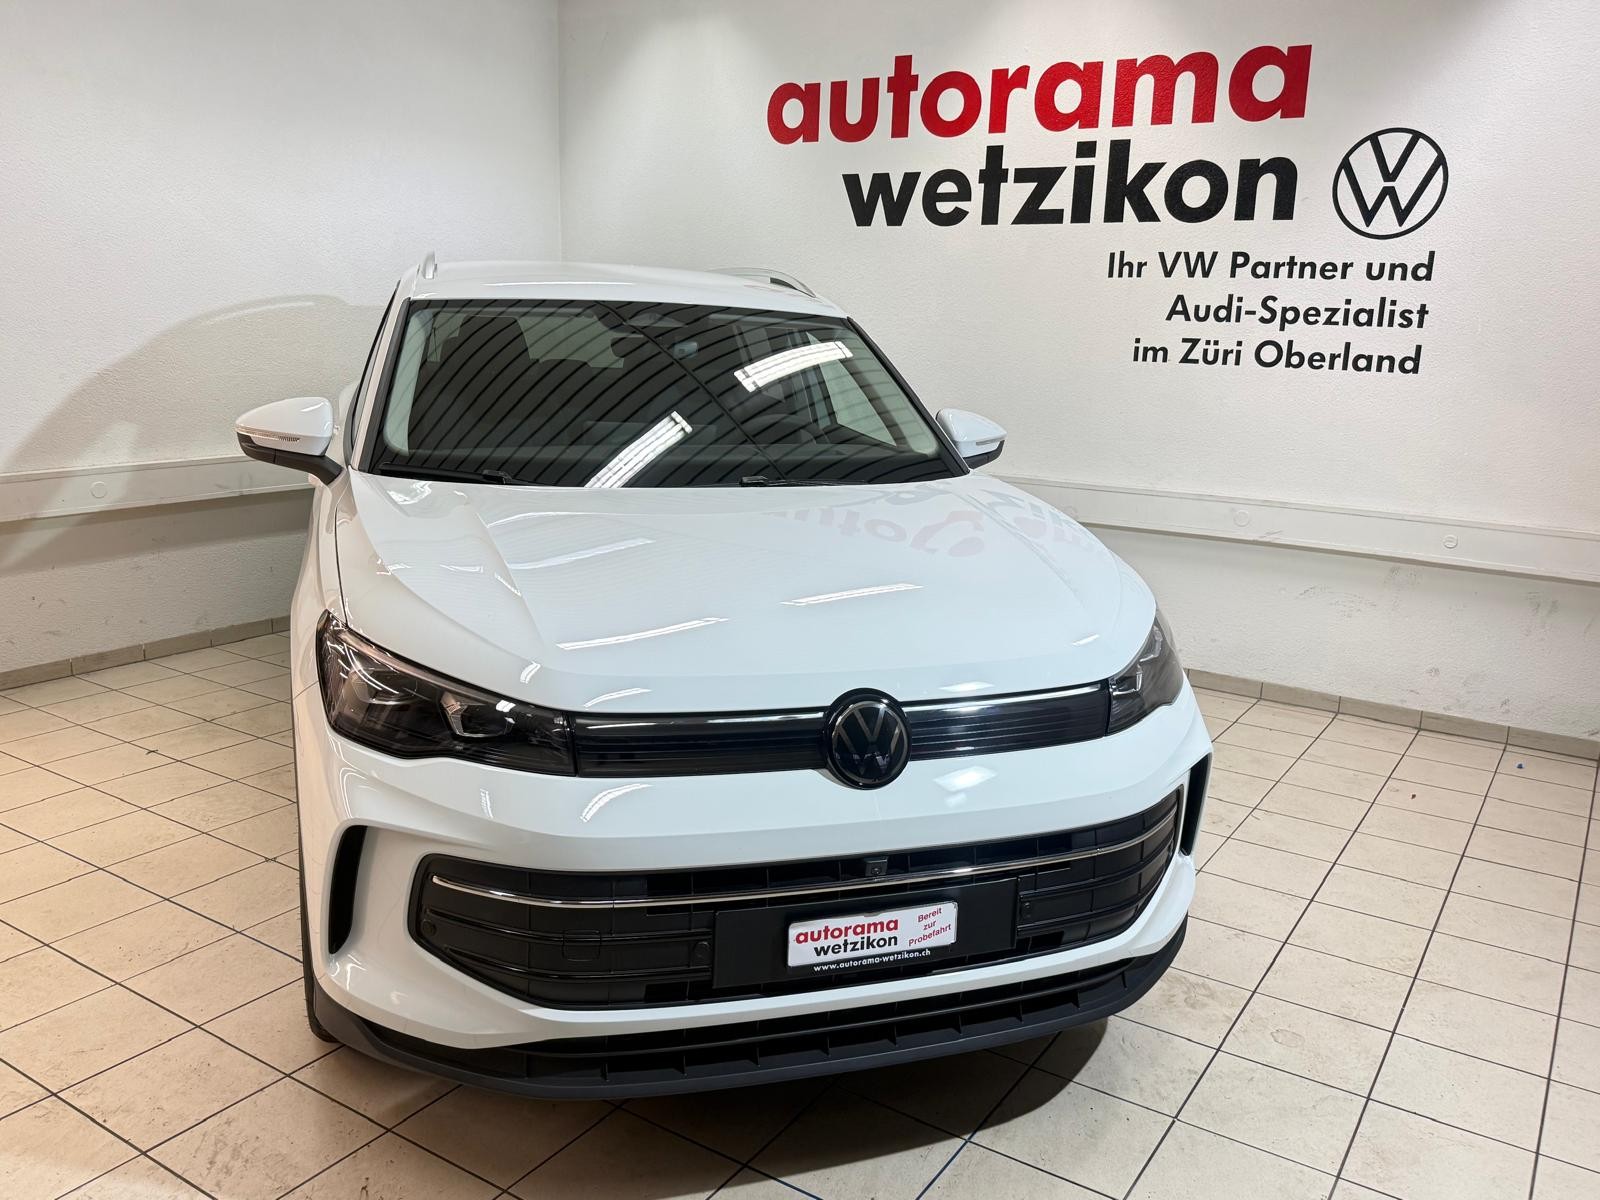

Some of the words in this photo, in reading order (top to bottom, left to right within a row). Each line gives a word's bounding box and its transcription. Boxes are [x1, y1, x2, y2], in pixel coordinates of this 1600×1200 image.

[767, 44, 1312, 145] autorama
[842, 140, 1298, 226] wetzikon
[1108, 252, 1146, 278] Ihr
[1157, 251, 1218, 278] VW
[1230, 252, 1354, 280] Partner
[1366, 251, 1435, 282] und
[1165, 295, 1429, 330] Audi-Spezialist
[1133, 339, 1169, 363] im
[1179, 339, 1242, 367] Züri
[1255, 340, 1422, 374] Oberland
[918, 907, 942, 923] Bereit
[924, 920, 936, 931] zur
[795, 919, 898, 944] autorama
[909, 924, 951, 947] Probefahrt
[814, 935, 897, 957] wetzikon
[814, 949, 930, 972] www.autorama-wetzikon.ch
